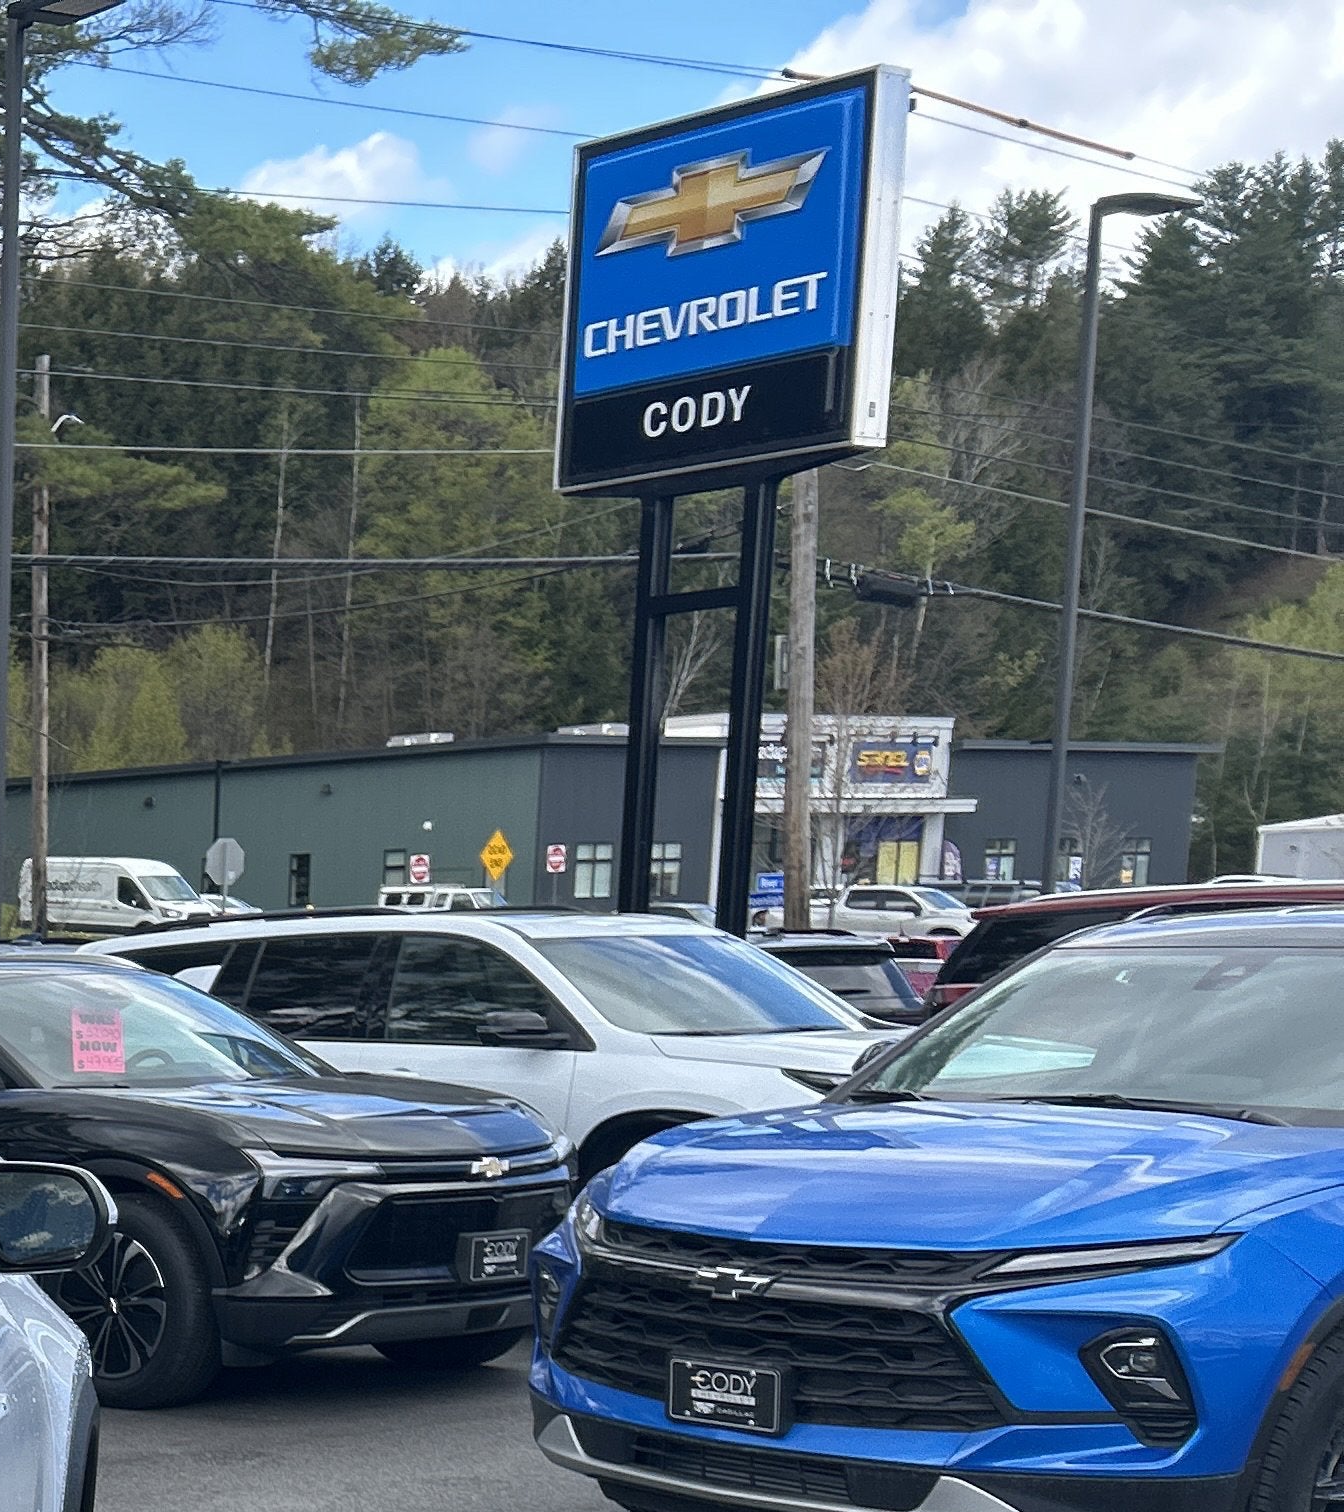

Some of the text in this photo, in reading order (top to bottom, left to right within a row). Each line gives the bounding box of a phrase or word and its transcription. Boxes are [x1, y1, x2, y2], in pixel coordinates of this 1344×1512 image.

[583, 271, 829, 359] CHEVROLET
[642, 384, 752, 439] CODY
[79, 1040, 118, 1053] NOW
[692, 1369, 757, 1396] CODY
